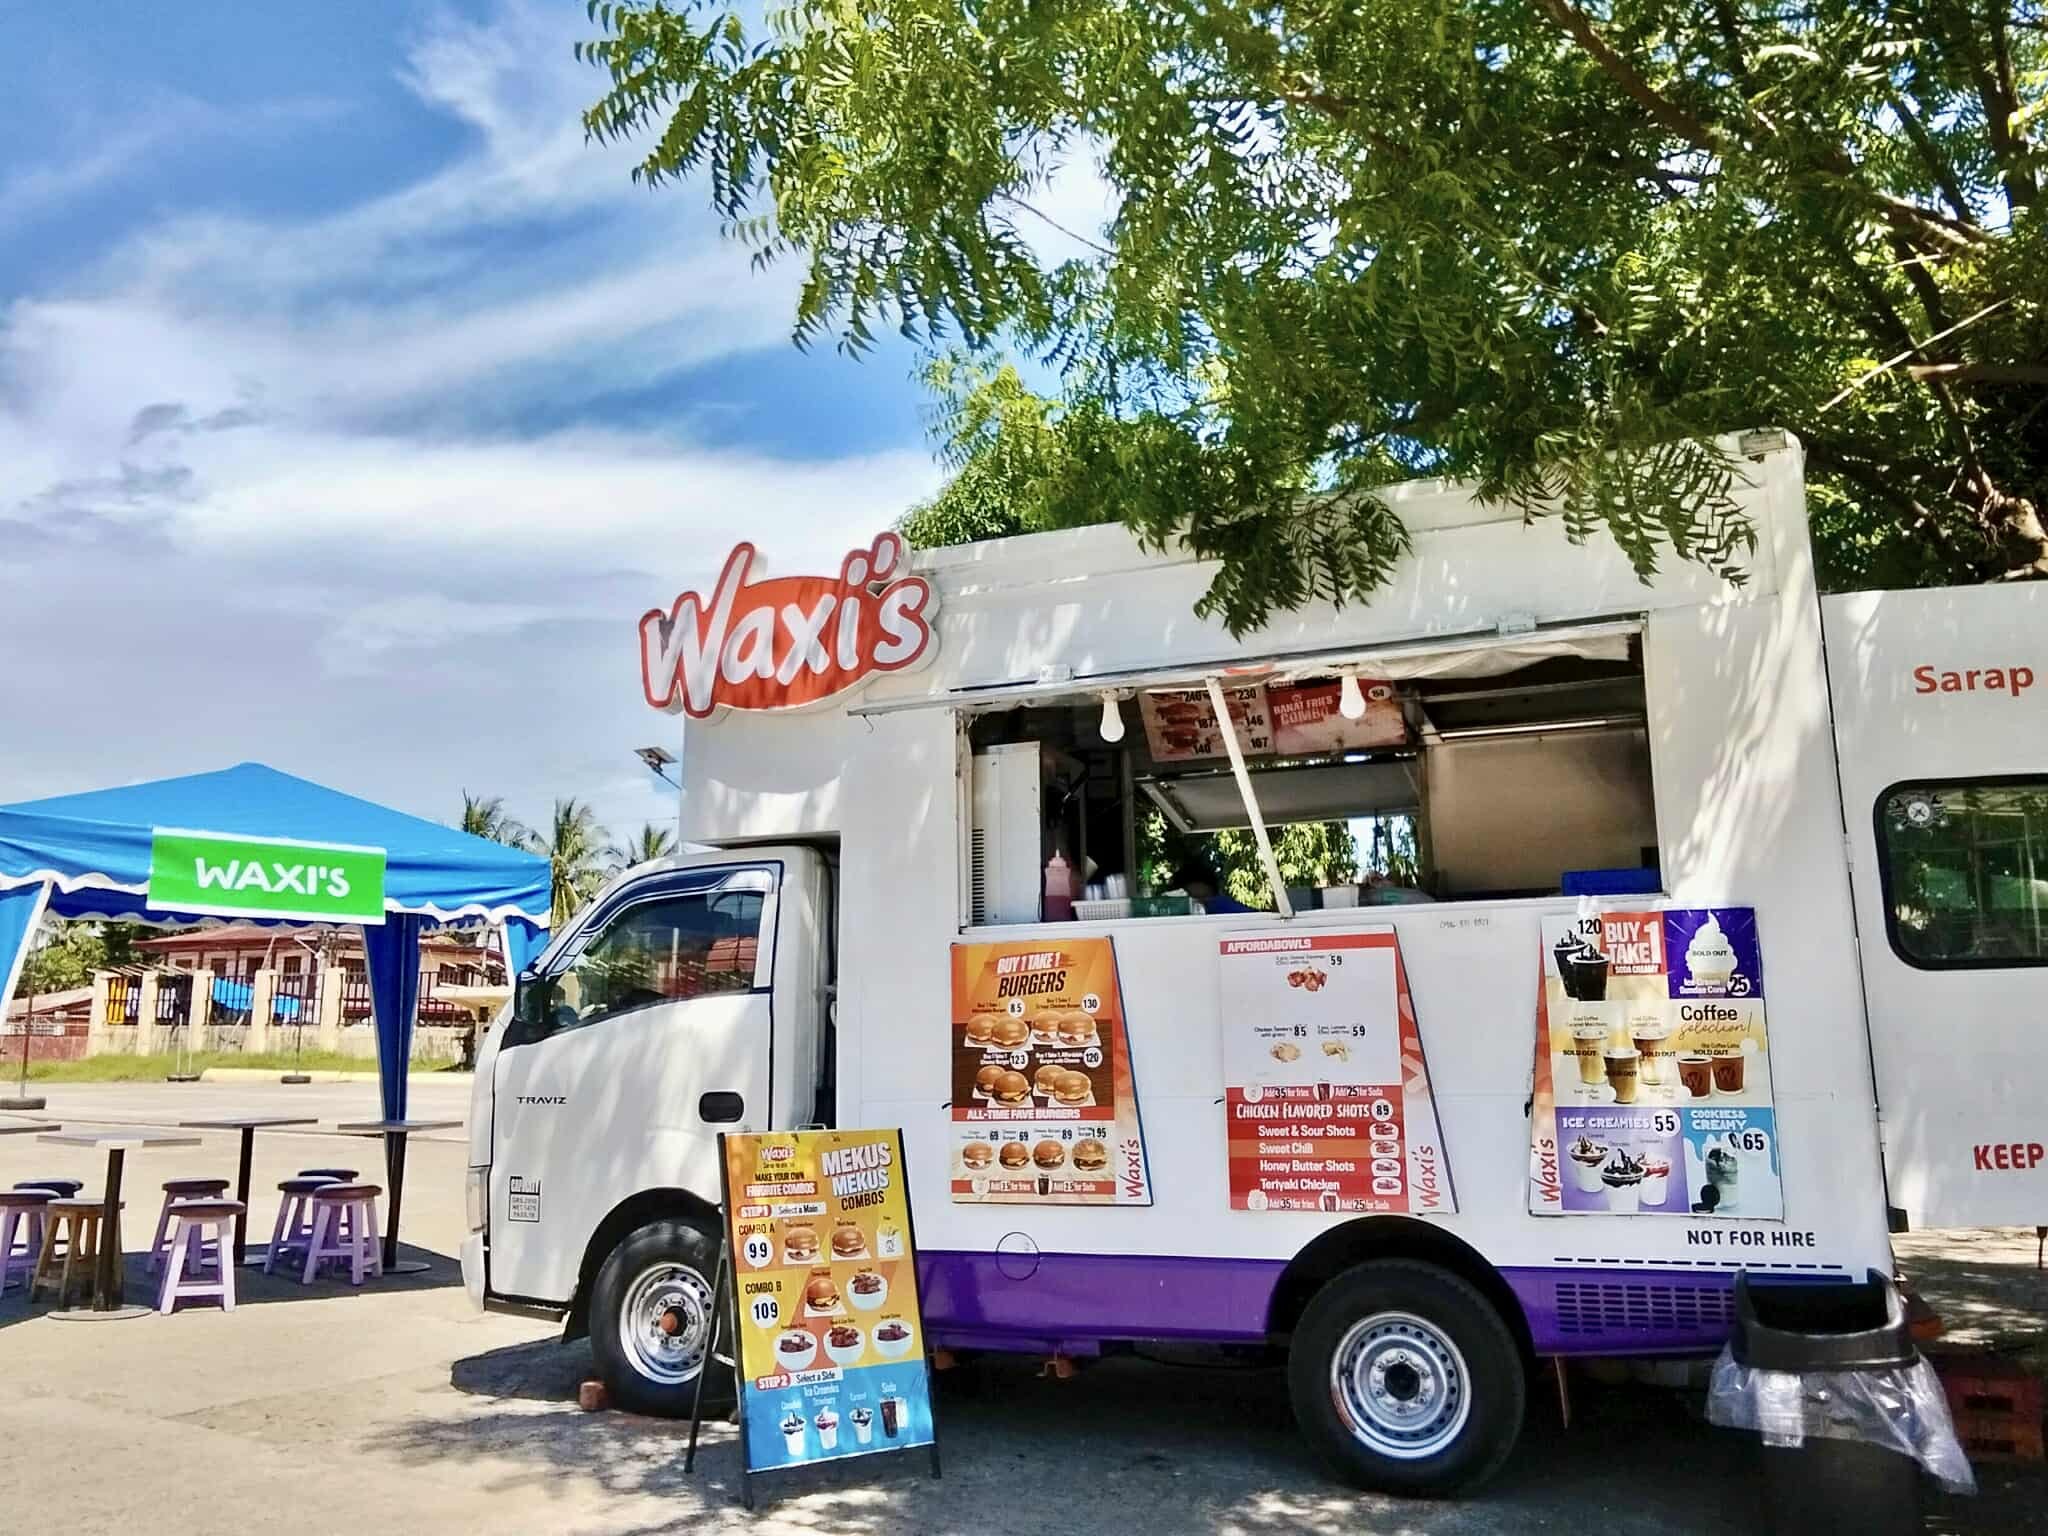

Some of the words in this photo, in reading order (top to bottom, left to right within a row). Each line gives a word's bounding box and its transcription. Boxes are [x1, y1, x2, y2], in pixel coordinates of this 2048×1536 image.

[643, 535, 926, 714] Waxi's
[1913, 665, 2034, 697] Sarap
[1238, 688, 1257, 701] 230
[1280, 707, 1329, 725] COMBO
[194, 857, 351, 898] WAXI'S
[1577, 918, 1602, 935] 120
[1603, 921, 1641, 943] BUY
[1227, 938, 1312, 953] AFFORDABOWLS
[1643, 920, 1662, 964] 1
[1606, 942, 1651, 965] TAKE
[997, 955, 1019, 974] BUY
[1028, 953, 1054, 970] TAKE
[1330, 955, 1342, 966] 59
[997, 970, 1067, 999] BURGERS
[1729, 974, 1748, 993] 25
[1009, 1003, 1022, 1013] 85
[1083, 998, 1098, 1009] 130
[1680, 1004, 1738, 1021] Coffee
[1293, 1025, 1307, 1037] 85
[1352, 1025, 1366, 1037] 59
[1010, 1054, 1026, 1065] 123
[1084, 1052, 1100, 1063] 120
[1264, 1088, 1275, 1097] Add
[1275, 1087, 1286, 1098] 35
[1335, 1086, 1347, 1096] Add
[1347, 1086, 1358, 1097] 25
[1368, 1086, 1383, 1097] Soda
[516, 1096, 567, 1105] TRAVIZ
[966, 1109, 1010, 1120] ALL-TIME
[1011, 1109, 1034, 1119] FAVE
[1036, 1108, 1081, 1119] BURGERS
[1337, 1103, 1370, 1118] SHOTS
[1376, 1104, 1389, 1116] 89
[1562, 1117, 1585, 1129] ICE
[1588, 1116, 1650, 1129] CREAMIES
[1654, 1114, 1675, 1132] 55
[1692, 1119, 1748, 1131] CREAMY
[989, 1130, 999, 1141] 69
[1018, 1131, 1029, 1142] 69
[1061, 1128, 1073, 1140] 89
[1258, 1125, 1289, 1137] Sweet
[1291, 1126, 1299, 1137] &
[1300, 1125, 1324, 1137] Sour
[1326, 1124, 1356, 1137] Shots
[1258, 1142, 1290, 1154] Sweet
[1743, 1133, 1765, 1151] 65
[822, 1142, 892, 1177] MEKUS
[1973, 1142, 2044, 1170] KEEP
[1259, 1160, 1290, 1173] Honey
[1292, 1160, 1324, 1172] Butter
[1325, 1160, 1356, 1172] Shots
[755, 1173, 773, 1182] MAKE
[774, 1172, 790, 1181] YOUR
[790, 1171, 804, 1180] OWN
[832, 1168, 889, 1197] MEKUS
[782, 1182, 816, 1195] COMBOS
[1259, 1178, 1299, 1191] Teriyaki
[1300, 1177, 1341, 1191] Chicken
[841, 1190, 885, 1211] COMBOS
[1280, 1198, 1291, 1209] 35
[1353, 1199, 1365, 1210] 25
[740, 1205, 763, 1218] STEP
[778, 1205, 797, 1215] Select
[803, 1204, 818, 1213] Main
[738, 1224, 767, 1236] COMBO
[769, 1223, 776, 1233] A
[1687, 1230, 1724, 1245] NOT
[1729, 1231, 1766, 1246] FOR
[1771, 1231, 1816, 1247] HIRE
[748, 1242, 768, 1259] 99
[745, 1281, 774, 1294] COMBO
[776, 1280, 783, 1292] B
[754, 1301, 779, 1321] 109
[758, 1377, 781, 1390] STEP
[780, 1375, 789, 1387] 2
[796, 1372, 816, 1384] Select
[821, 1370, 836, 1381] Side
